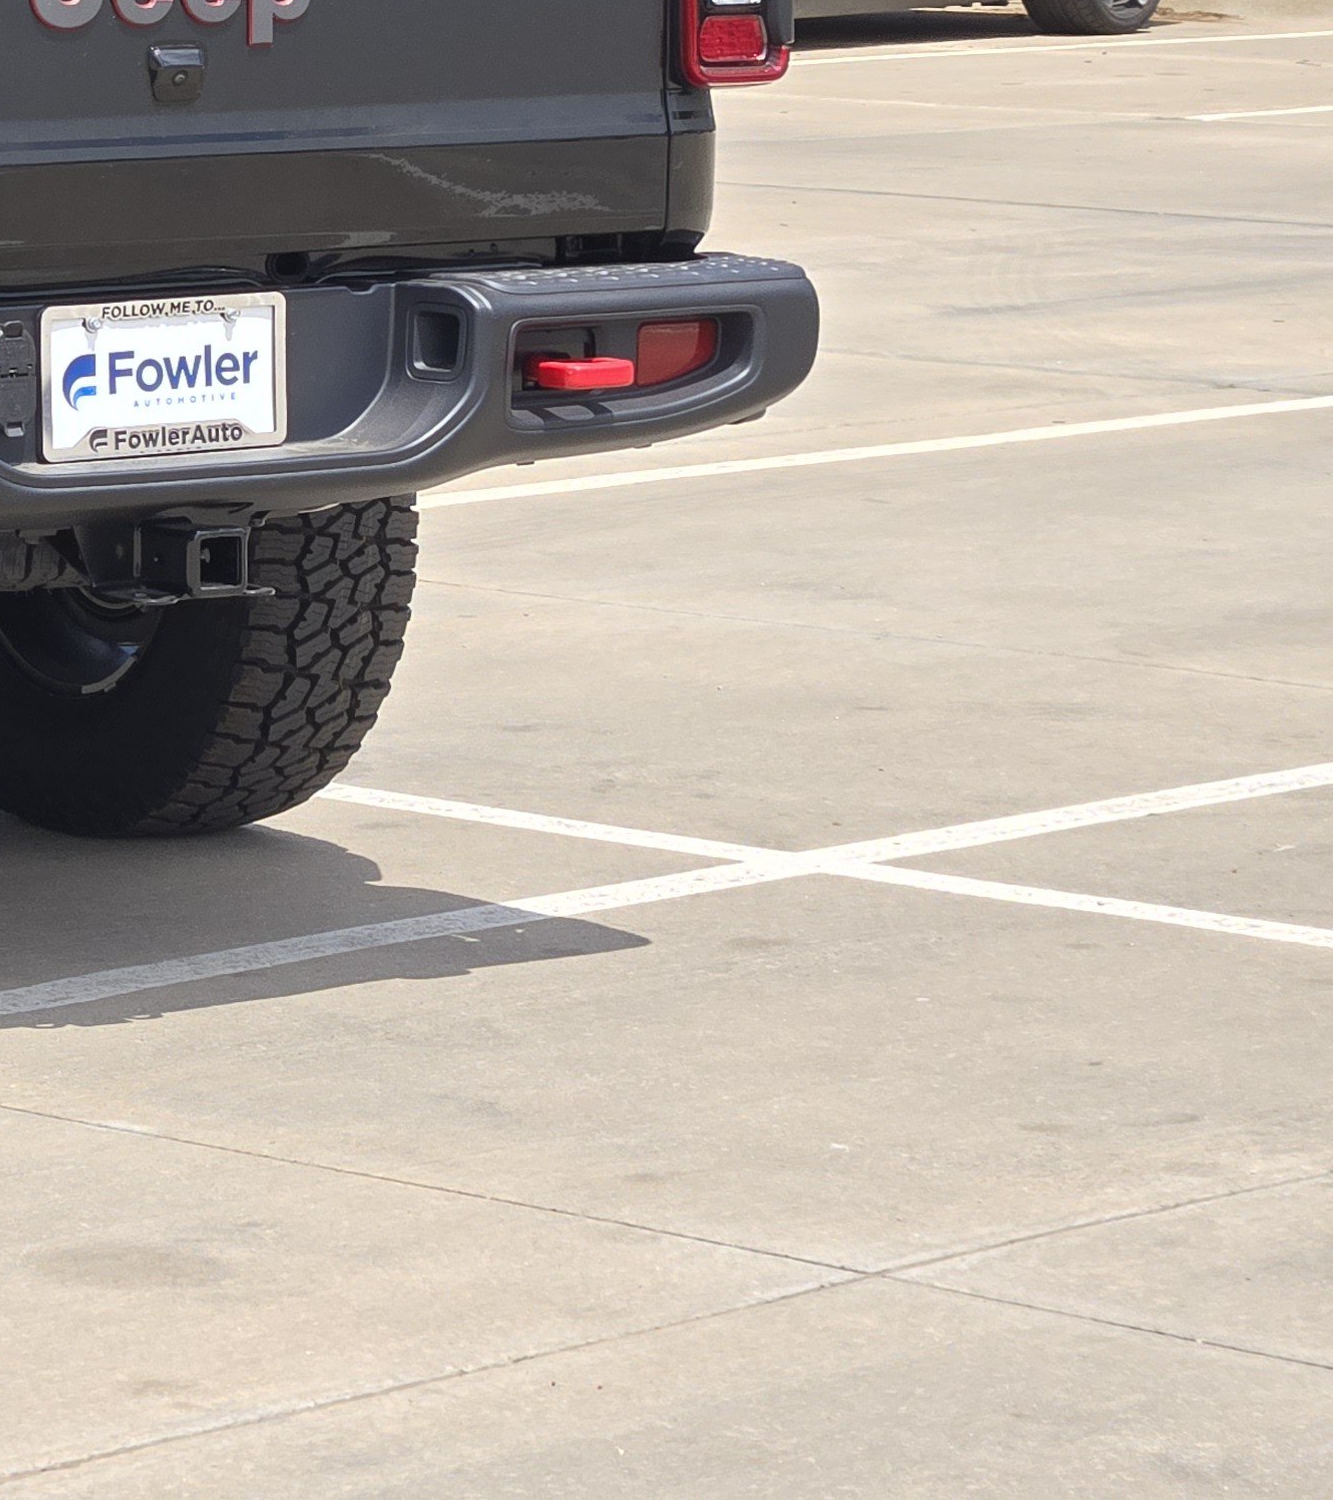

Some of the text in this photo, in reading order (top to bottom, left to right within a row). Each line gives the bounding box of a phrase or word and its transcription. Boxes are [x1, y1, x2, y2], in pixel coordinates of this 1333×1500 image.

[101, 302, 167, 320] FOLLOW
[169, 300, 191, 314] ME
[108, 344, 259, 395] Fowler
[133, 392, 237, 408] AUTOMOTIVE
[113, 422, 243, 450] FowlerAuto
